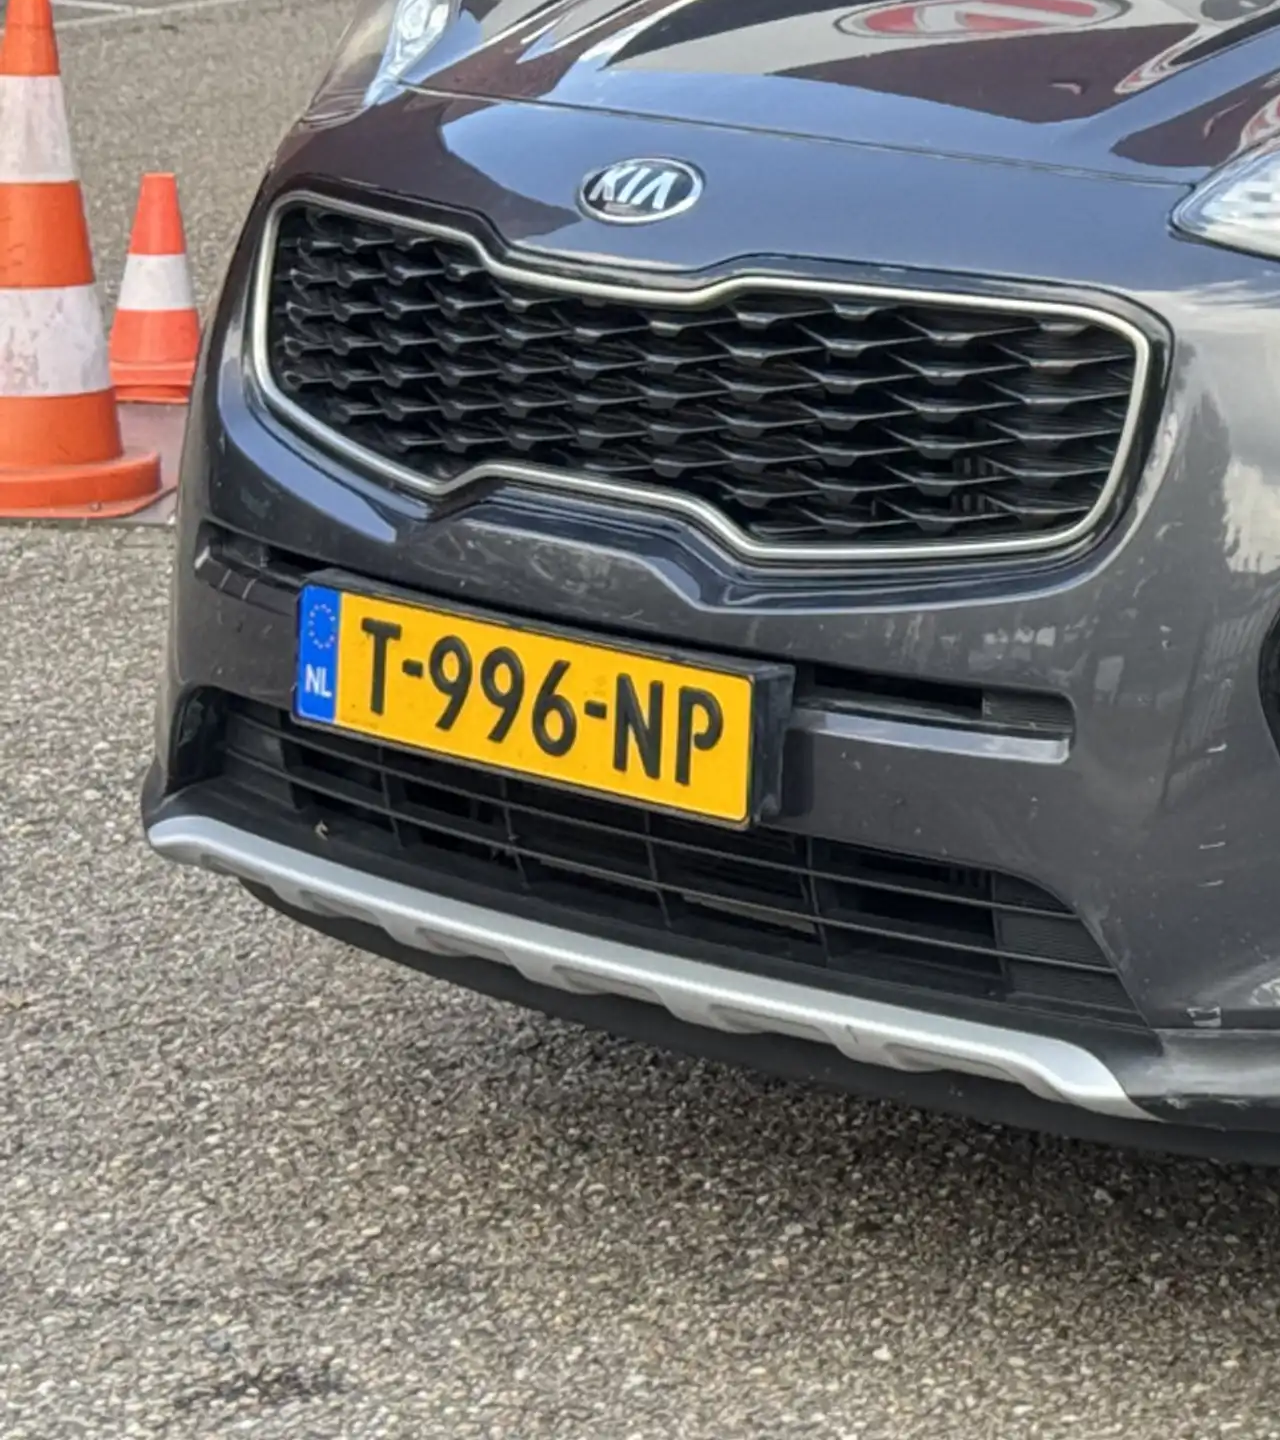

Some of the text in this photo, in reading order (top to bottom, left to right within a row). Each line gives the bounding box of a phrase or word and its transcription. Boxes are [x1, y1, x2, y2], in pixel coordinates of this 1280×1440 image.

[588, 165, 680, 211] KIA
[304, 664, 333, 698] NL
[359, 617, 726, 787] T-996-NP
